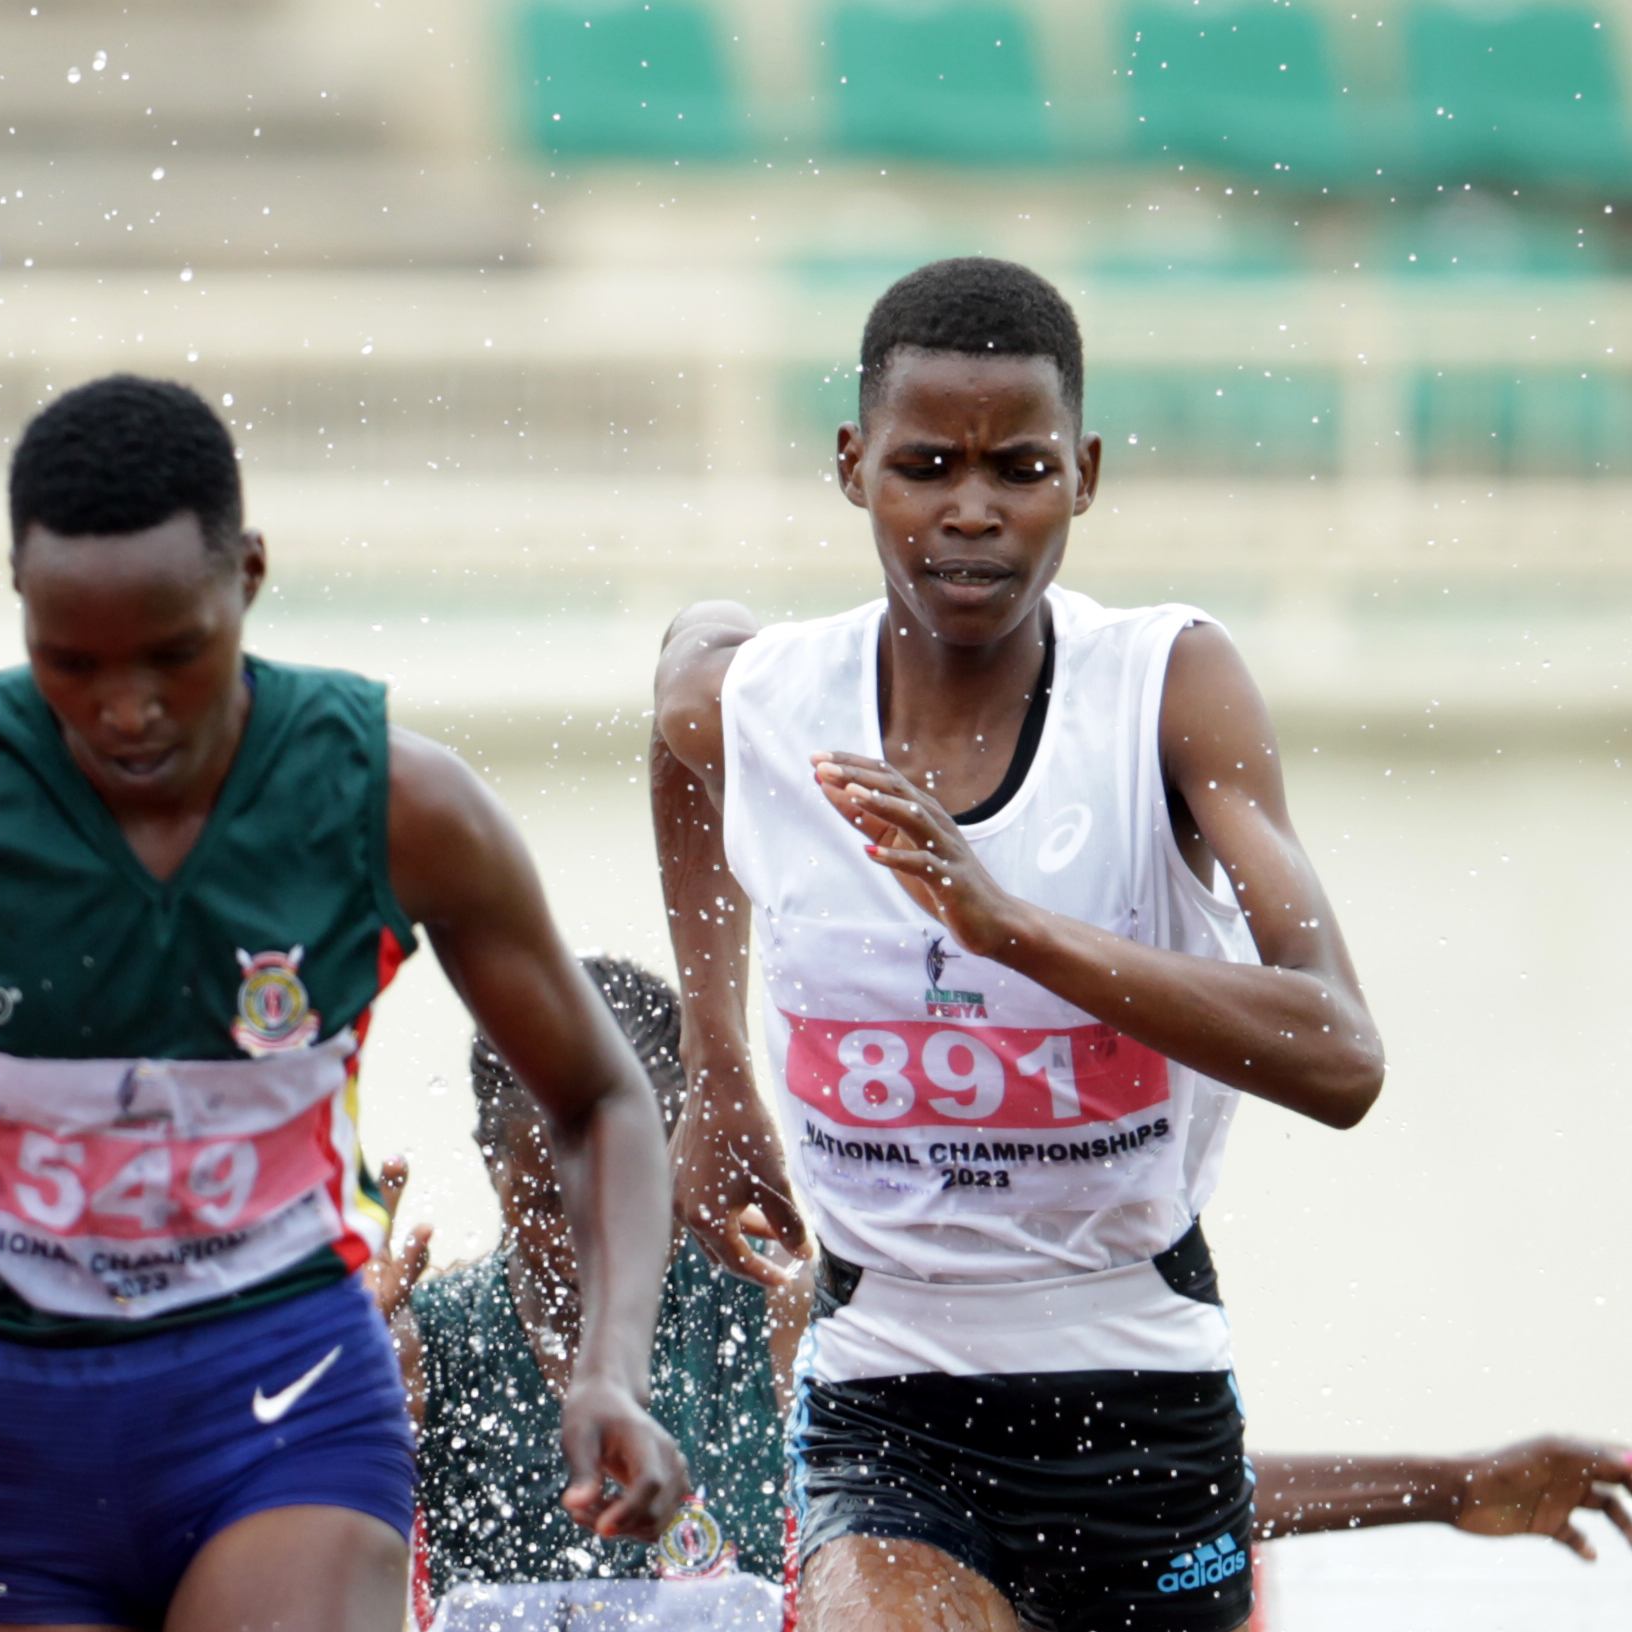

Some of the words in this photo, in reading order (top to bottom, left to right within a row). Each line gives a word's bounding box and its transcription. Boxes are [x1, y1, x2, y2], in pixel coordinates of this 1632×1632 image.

[927, 1003, 988, 1018] KENYA
[837, 1028, 1082, 1120] 891
[806, 1119, 920, 1164] NATIONAL
[929, 1117, 1169, 1164] CHAMPIONSHIPS
[13, 1131, 258, 1229] 549
[941, 1168, 1009, 1190] 2023
[1157, 1550, 1245, 1593] adidas
